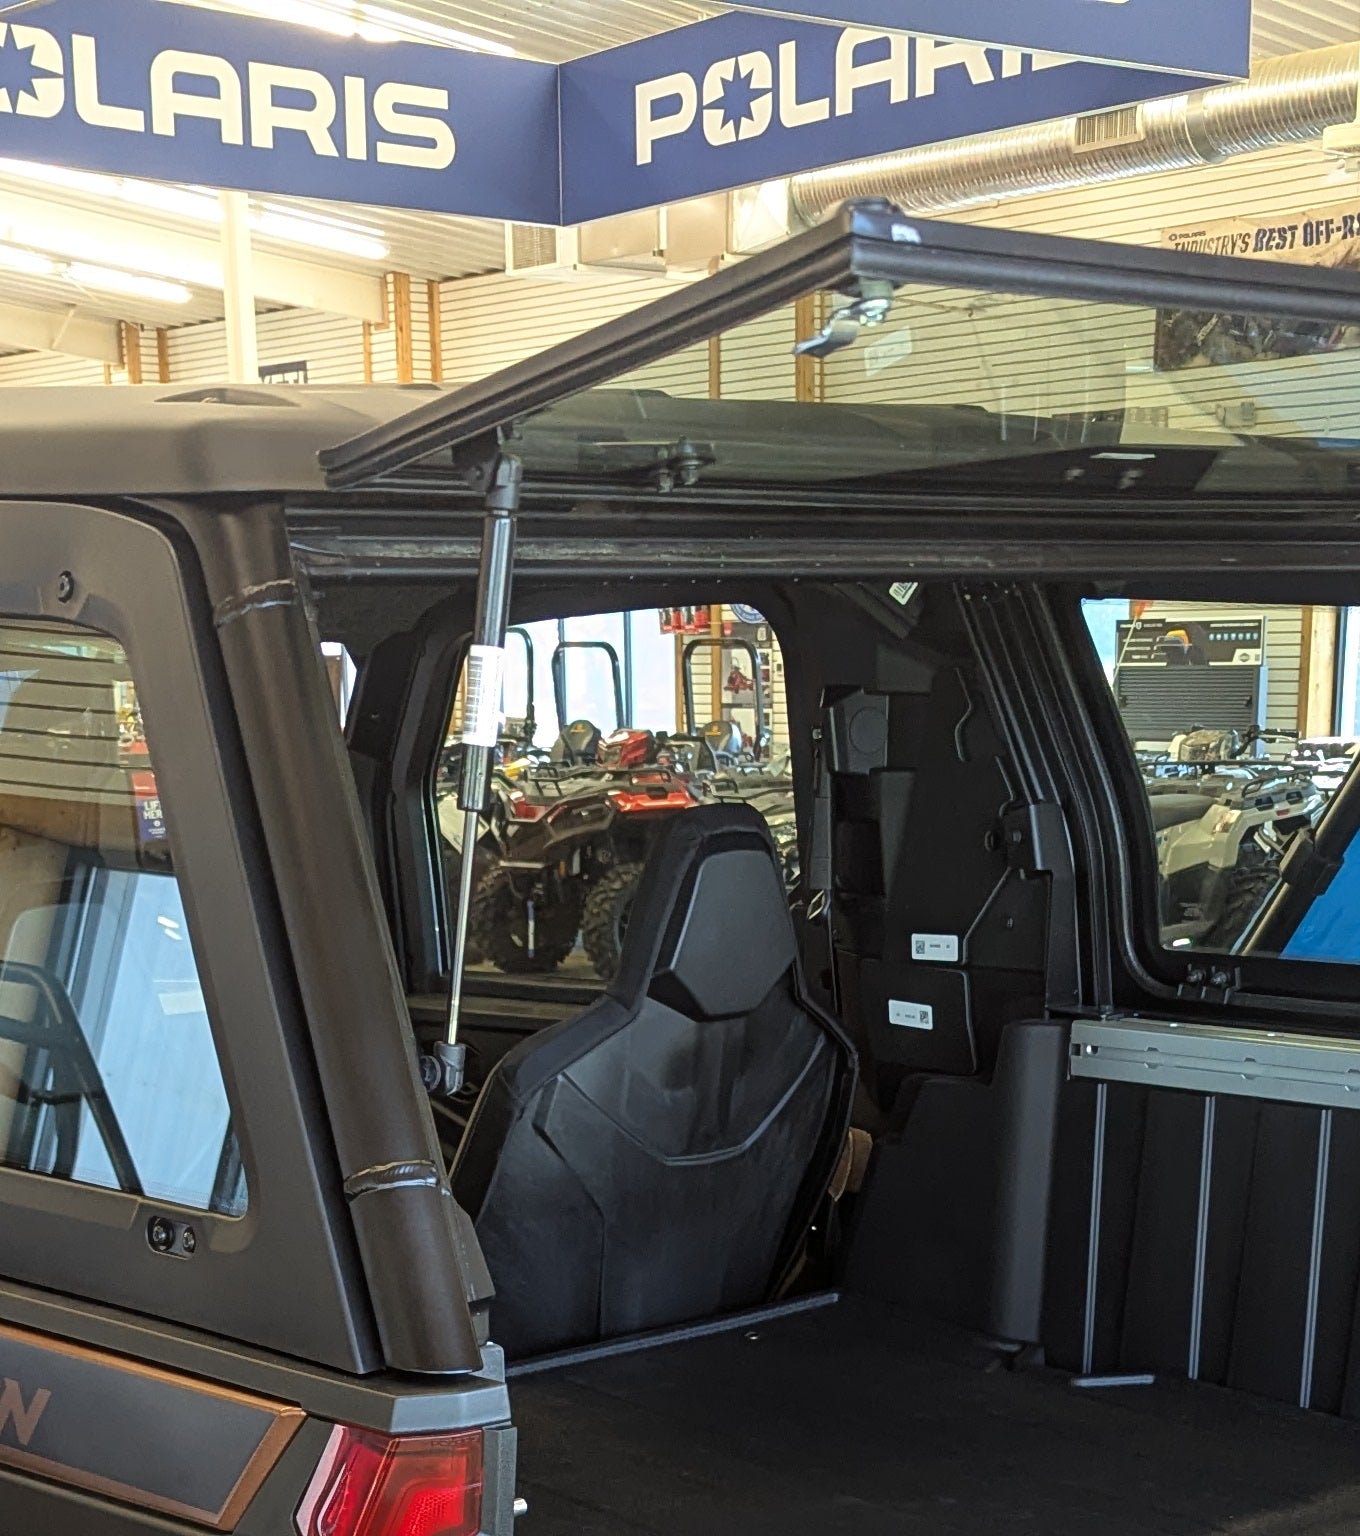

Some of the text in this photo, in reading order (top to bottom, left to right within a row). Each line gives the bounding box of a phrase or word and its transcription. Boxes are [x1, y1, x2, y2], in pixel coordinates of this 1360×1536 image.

[635, 27, 1078, 166] POLAR
[1178, 230, 1206, 239] POLARIS
[1253, 224, 1297, 252] BEST
